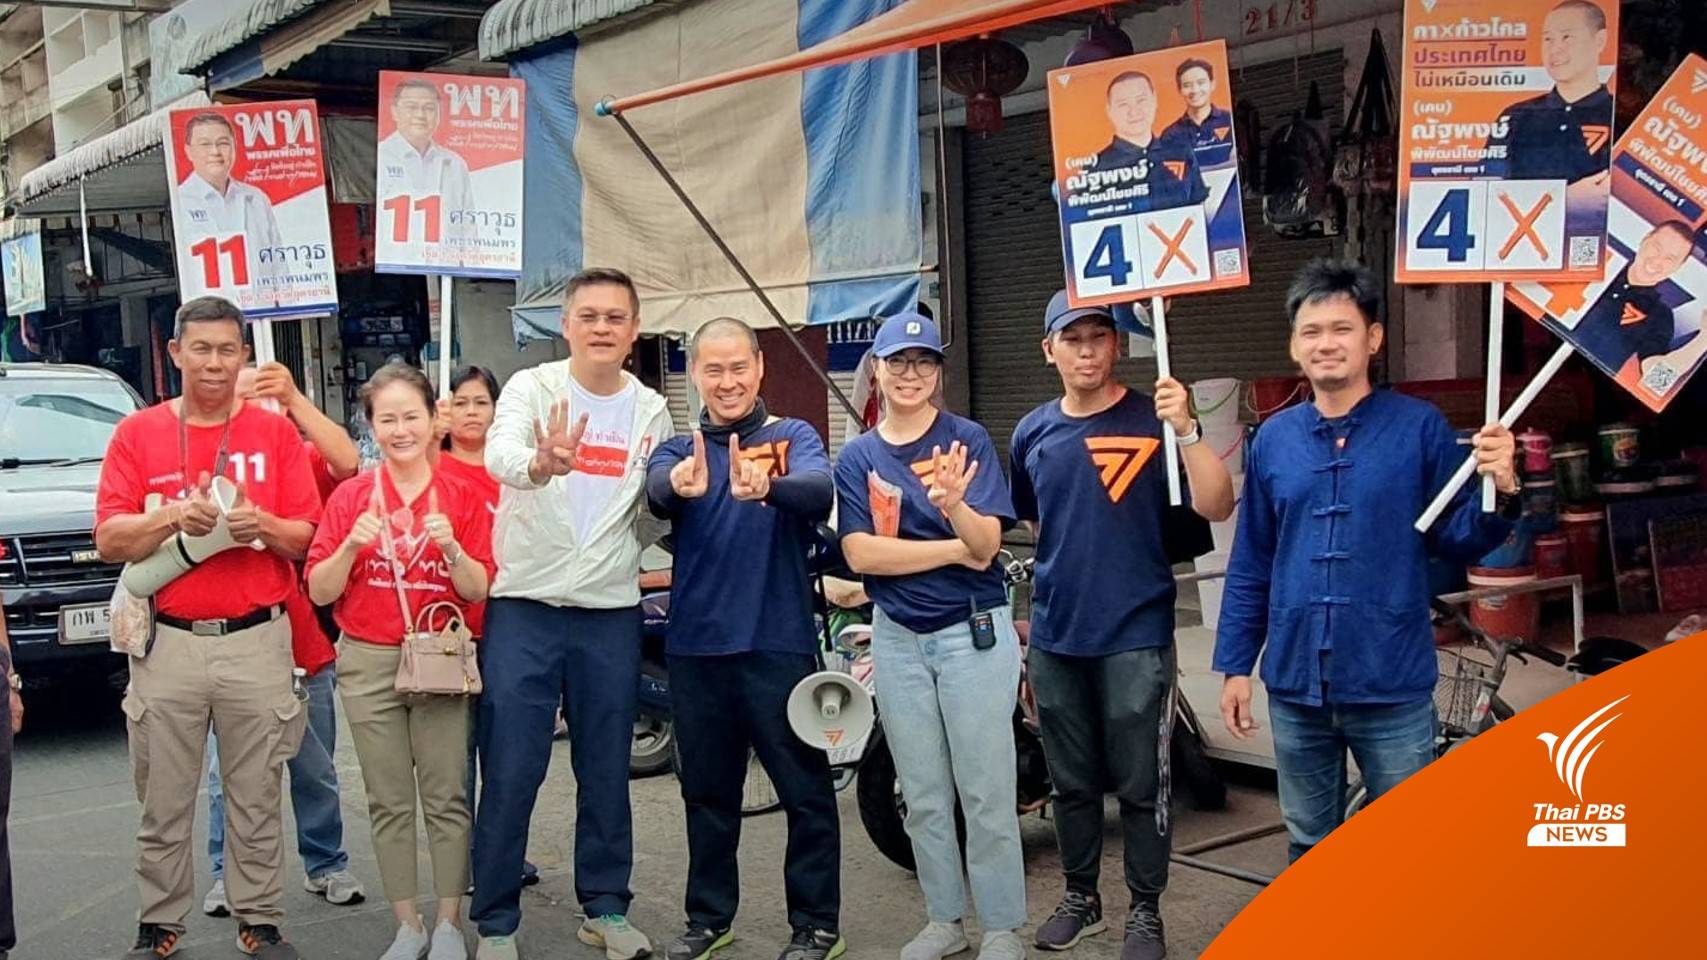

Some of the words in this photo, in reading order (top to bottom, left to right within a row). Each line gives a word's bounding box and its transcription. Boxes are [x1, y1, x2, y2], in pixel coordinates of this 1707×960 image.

[1415, 43, 1526, 64] ประเทศไทย
[1414, 71, 1526, 88] ไม่เหมือนเดิม
[444, 83, 519, 119] พท
[1413, 100, 1453, 116] (เคน)
[234, 108, 314, 147] พท
[1411, 116, 1511, 145] ณัฐพงษ์
[1643, 116, 1707, 175] ณัฐพ
[1066, 159, 1149, 191] ณัฐพงษ์
[384, 194, 441, 243] 11
[449, 208, 517, 236] ศราวุธ
[1416, 189, 1475, 262] 4
[191, 234, 249, 288] 11
[259, 243, 327, 270] ศราวุธ
[1083, 224, 1133, 286] 4
[228, 451, 266, 482] 11
